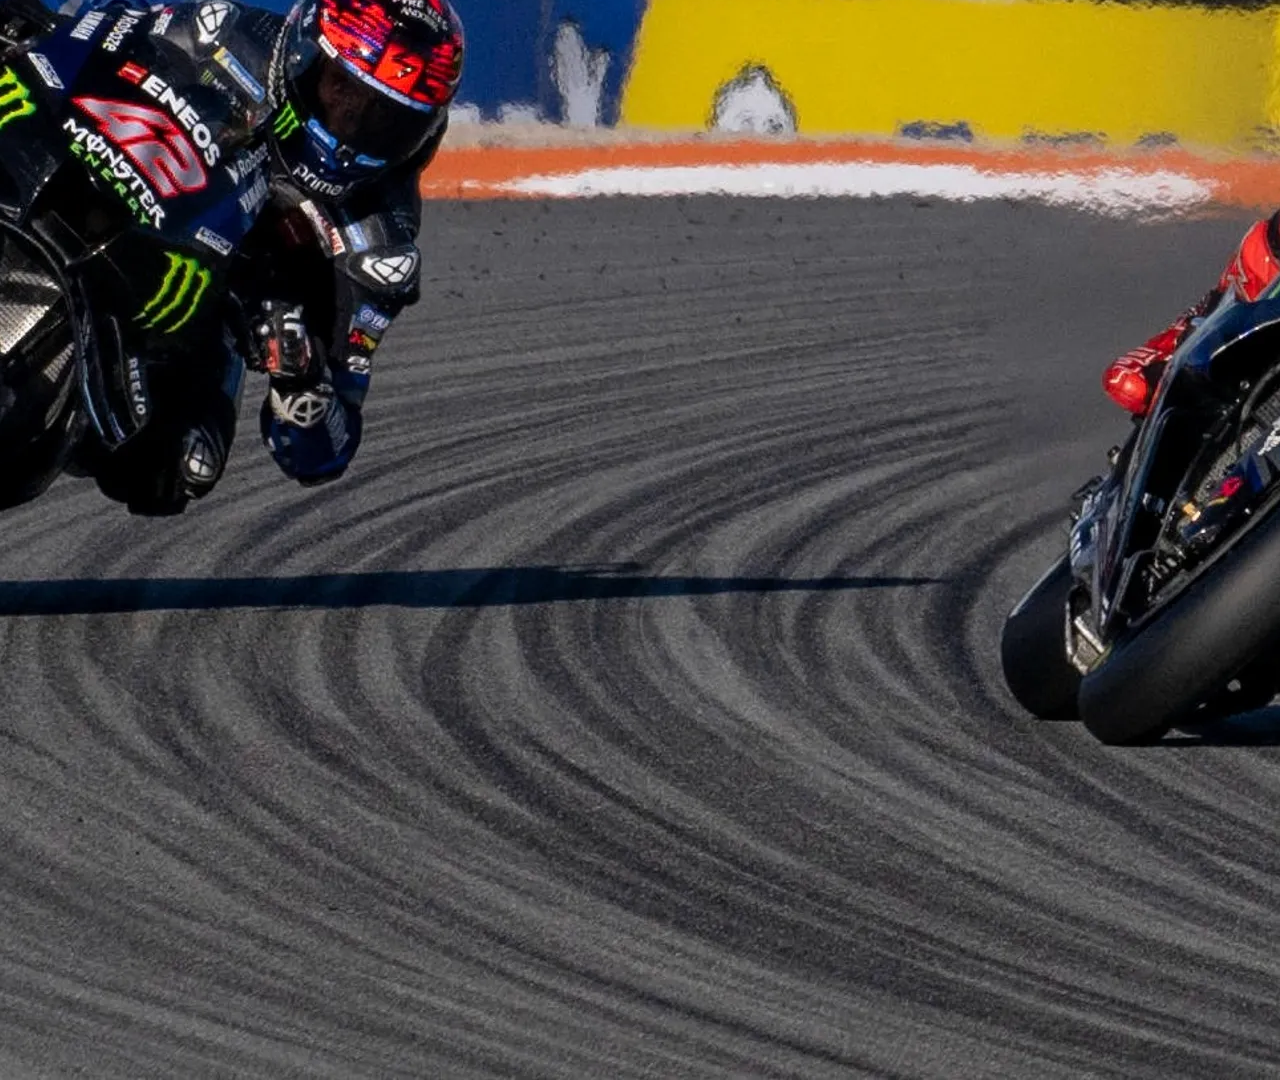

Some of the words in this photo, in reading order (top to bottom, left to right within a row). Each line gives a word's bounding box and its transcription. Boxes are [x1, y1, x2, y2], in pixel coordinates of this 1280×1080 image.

[102, 14, 139, 52] Roboze
[71, 96, 209, 199] 42
[141, 74, 221, 167] ENEOS
[69, 142, 151, 225] ENERGY
[292, 163, 344, 197] prima
[127, 357, 147, 416] REEJO
